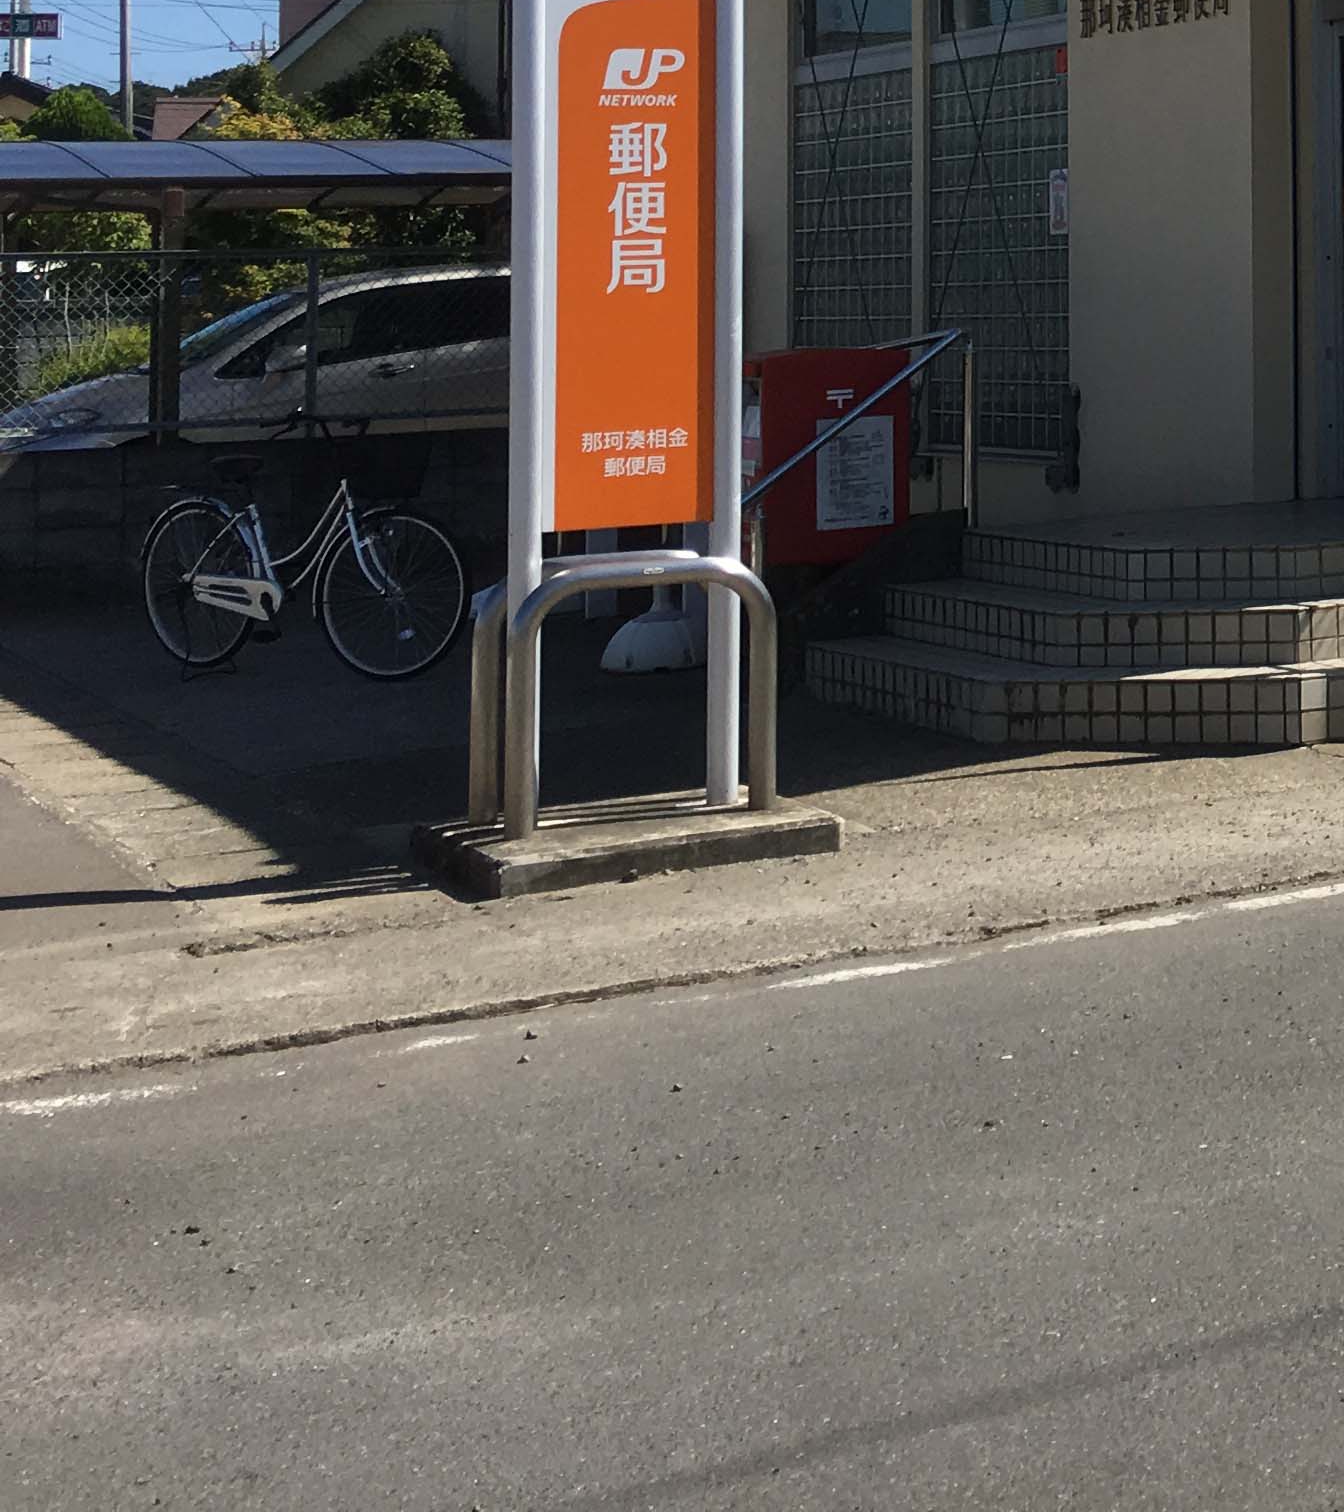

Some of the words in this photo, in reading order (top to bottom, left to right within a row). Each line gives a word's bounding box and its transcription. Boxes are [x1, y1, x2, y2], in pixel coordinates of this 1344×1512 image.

[602, 48, 685, 90] JP
[598, 94, 677, 107] NETWORK
[606, 121, 668, 295] 郵便局
[580, 426, 689, 454] 那珂湊相金
[603, 455, 667, 478] 郵便局
